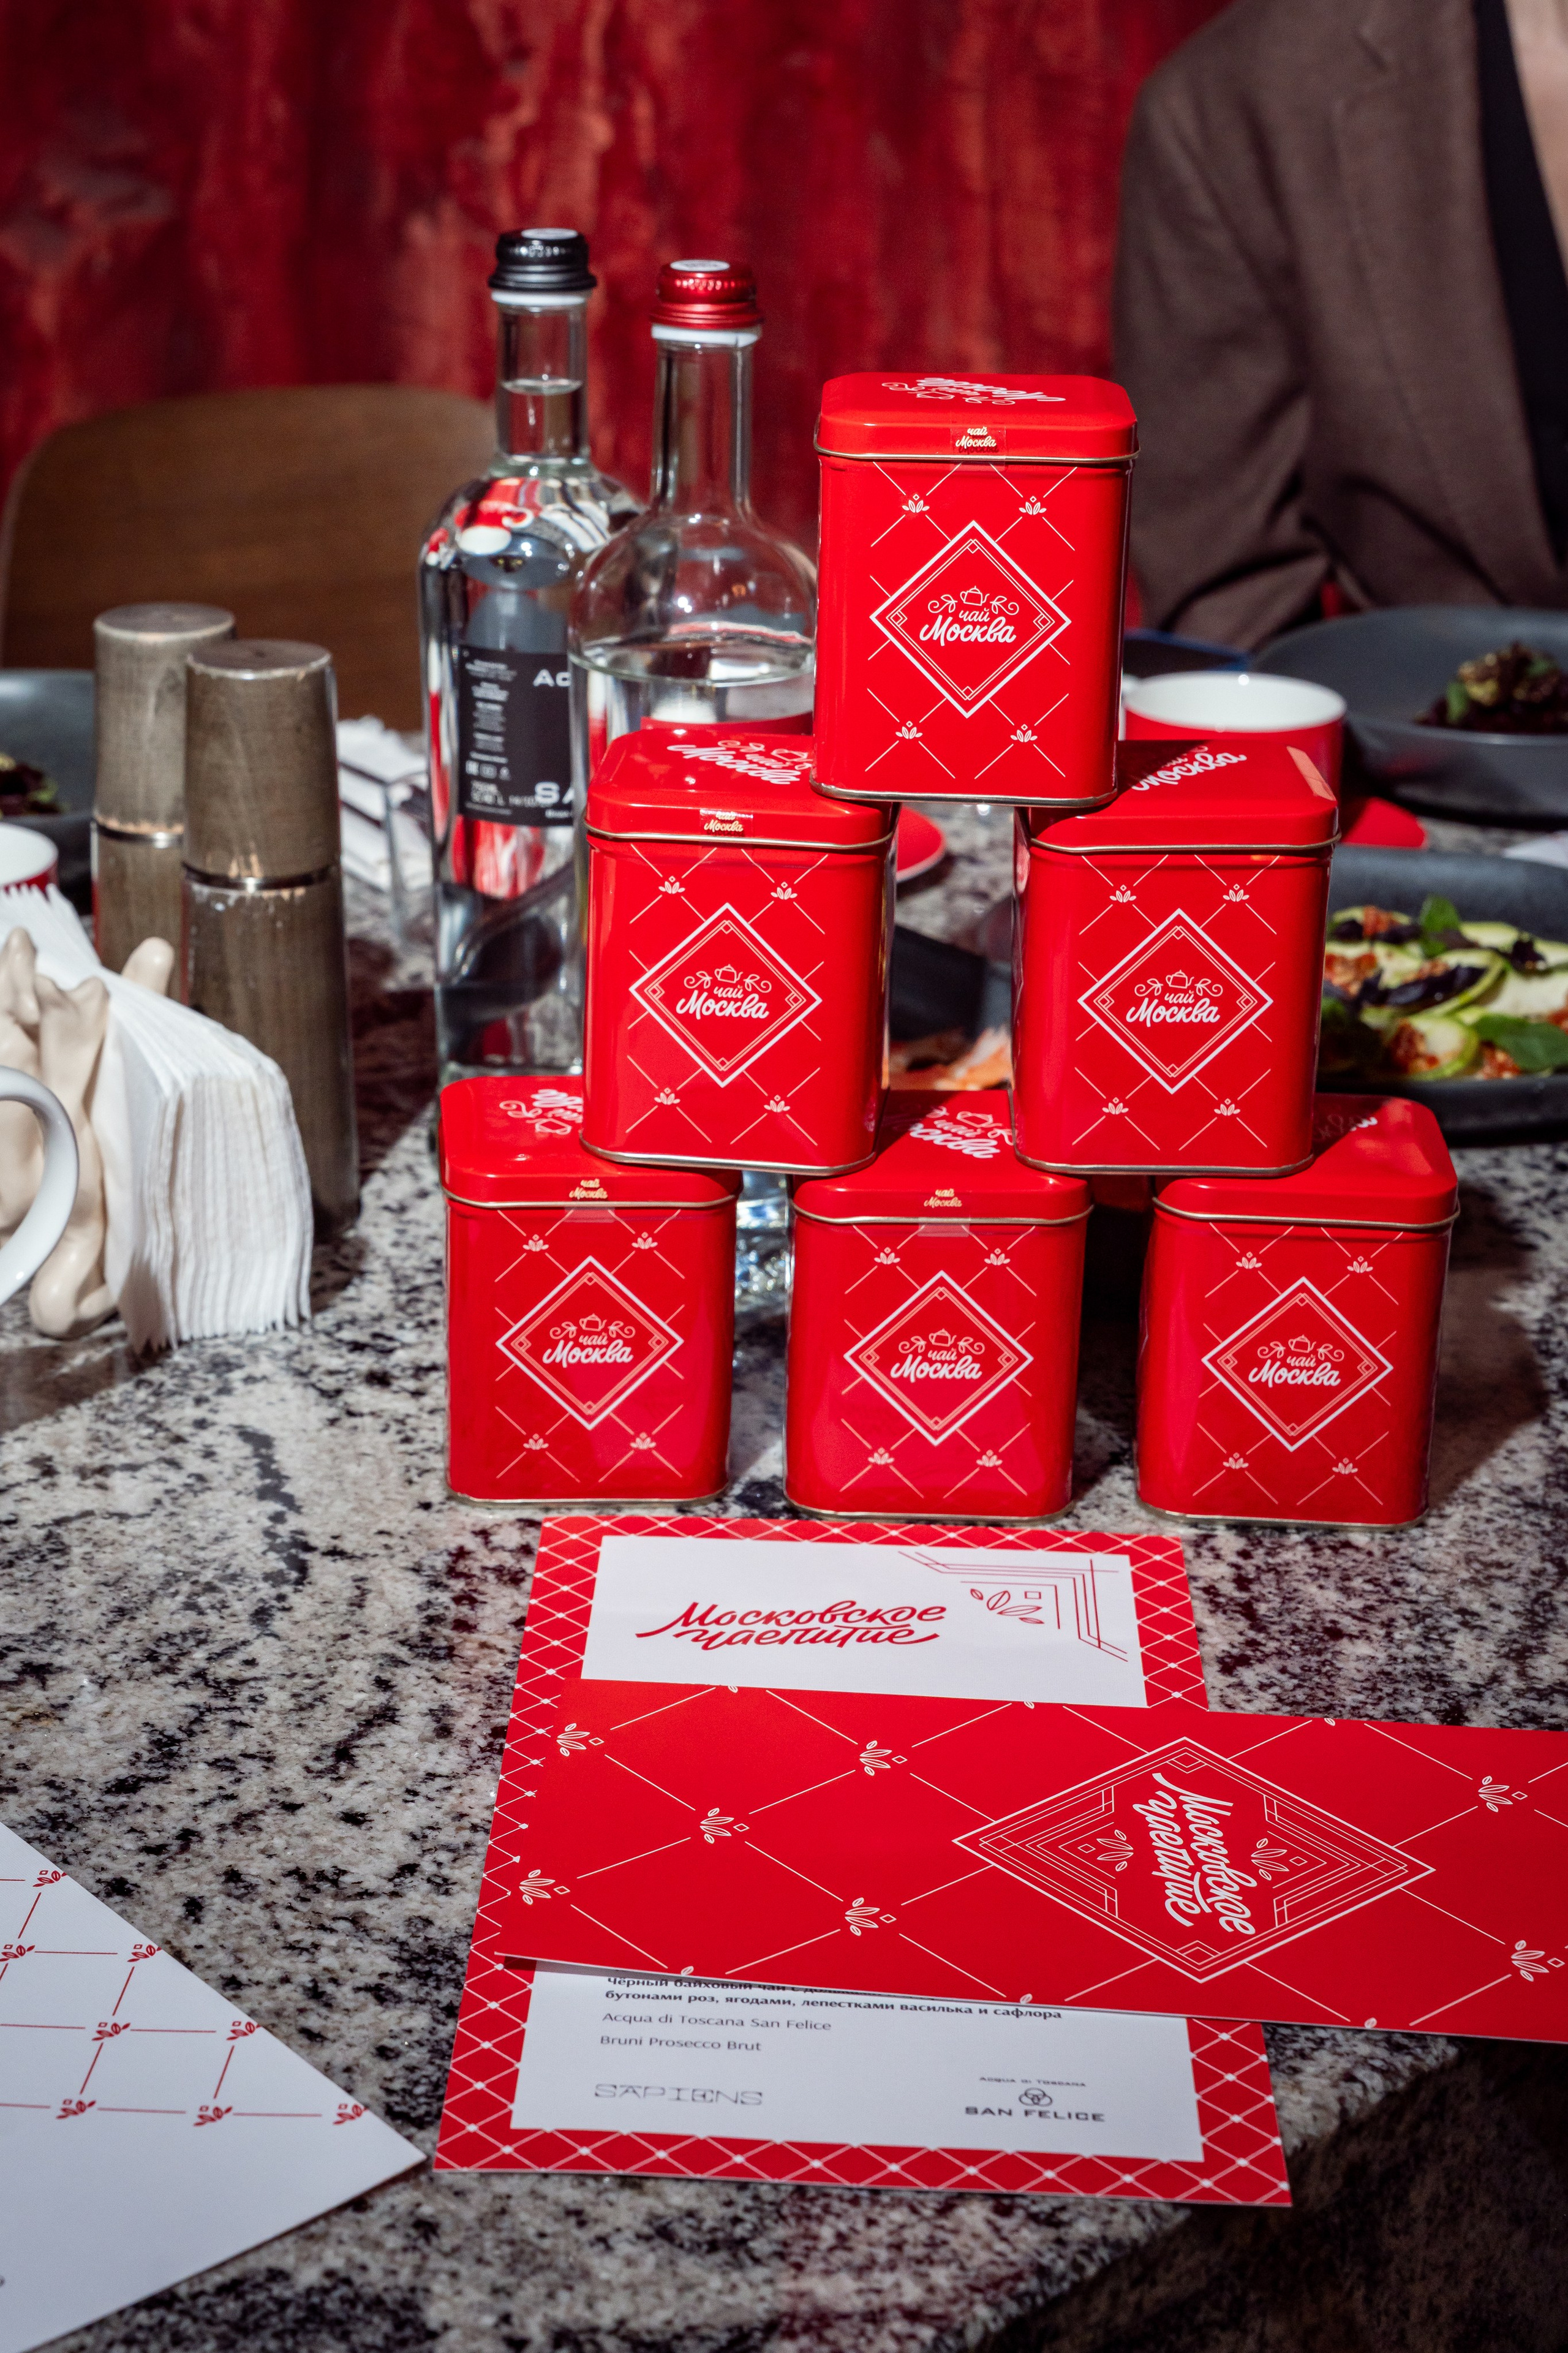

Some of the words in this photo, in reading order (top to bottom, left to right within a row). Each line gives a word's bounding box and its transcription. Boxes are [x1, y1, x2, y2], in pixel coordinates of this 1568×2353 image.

[967, 426, 987, 436] чай
[956, 436, 997, 449] Москва
[959, 607, 990, 622] чай
[919, 614, 1017, 646] Москва
[704, 820, 744, 833] Москва
[714, 984, 744, 999] чай
[1164, 989, 1194, 1003] чай
[676, 989, 769, 1020] Москва
[1126, 997, 1220, 1028] Москва
[569, 1187, 608, 1200] Москва
[924, 1196, 962, 1208] Москва
[579, 1332, 608, 1346] чай
[542, 1340, 633, 1369] Москва
[927, 1347, 957, 1362] чай
[1286, 1353, 1316, 1367] чай
[891, 1354, 982, 1383] Москва
[1248, 1359, 1341, 1388] Москва
[635, 1600, 947, 1638] Московское
[673, 1623, 940, 1651] чаепитие
[1152, 1772, 1257, 1935] Московское
[605, 1990, 682, 2001] бутонами
[688, 1994, 719, 2003] роз,
[725, 1996, 796, 2007] ягодами,
[801, 1999, 894, 2009] лепестками
[900, 2004, 973, 2014] василька
[993, 2007, 1061, 2020] сафлора
[602, 2012, 652, 2025] Acqua
[658, 2013, 673, 2023] di
[679, 2015, 745, 2026] Toscana
[750, 2018, 780, 2028] San
[786, 2020, 832, 2030] Felice
[600, 2035, 643, 2045] Bruni
[649, 2036, 721, 2049] Prosecco
[727, 2041, 762, 2051] Brut
[595, 2083, 763, 2106] SAPIENS
[965, 2106, 1012, 2117] SAN
[1024, 2109, 1105, 2122] FELICE
